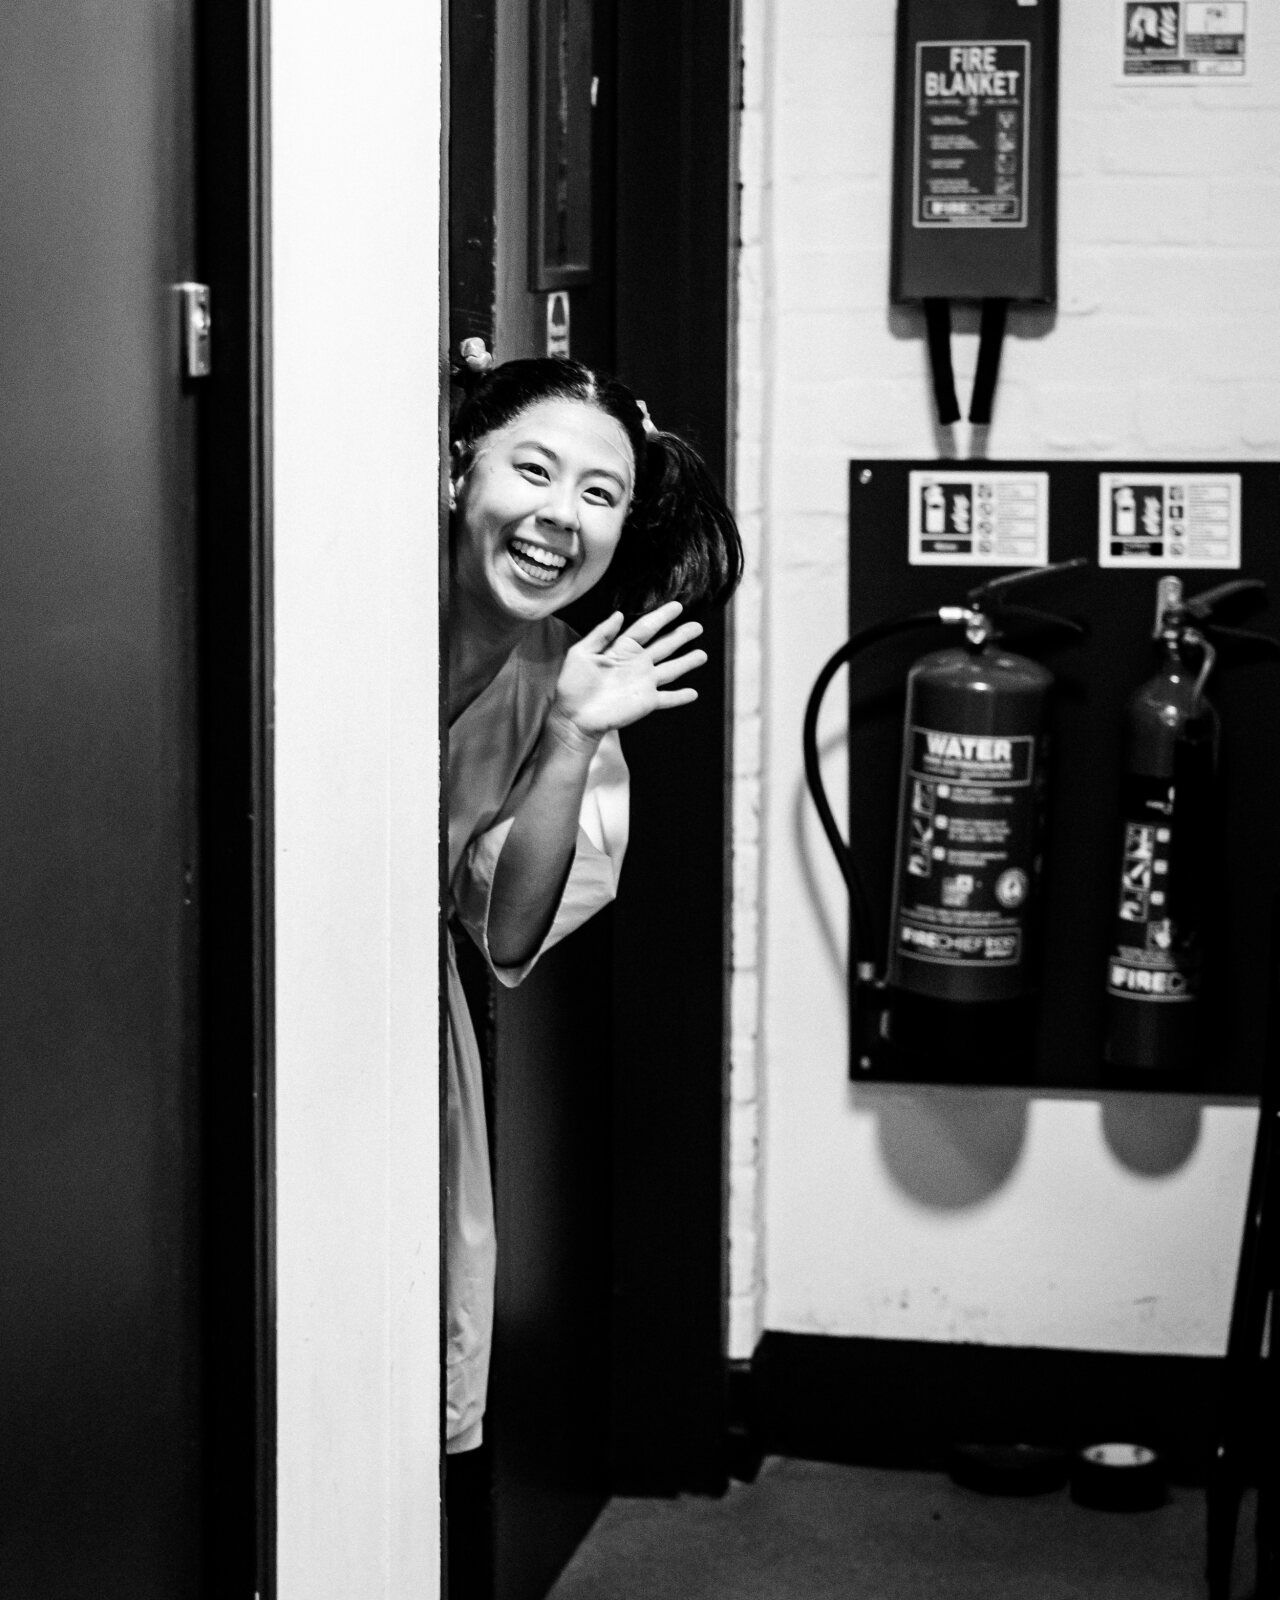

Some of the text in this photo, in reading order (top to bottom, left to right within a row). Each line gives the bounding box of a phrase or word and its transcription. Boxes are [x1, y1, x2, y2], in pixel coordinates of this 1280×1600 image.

[950, 47, 997, 72] FIRE
[925, 71, 1019, 96] BLANKET
[927, 733, 1011, 761] WATER
